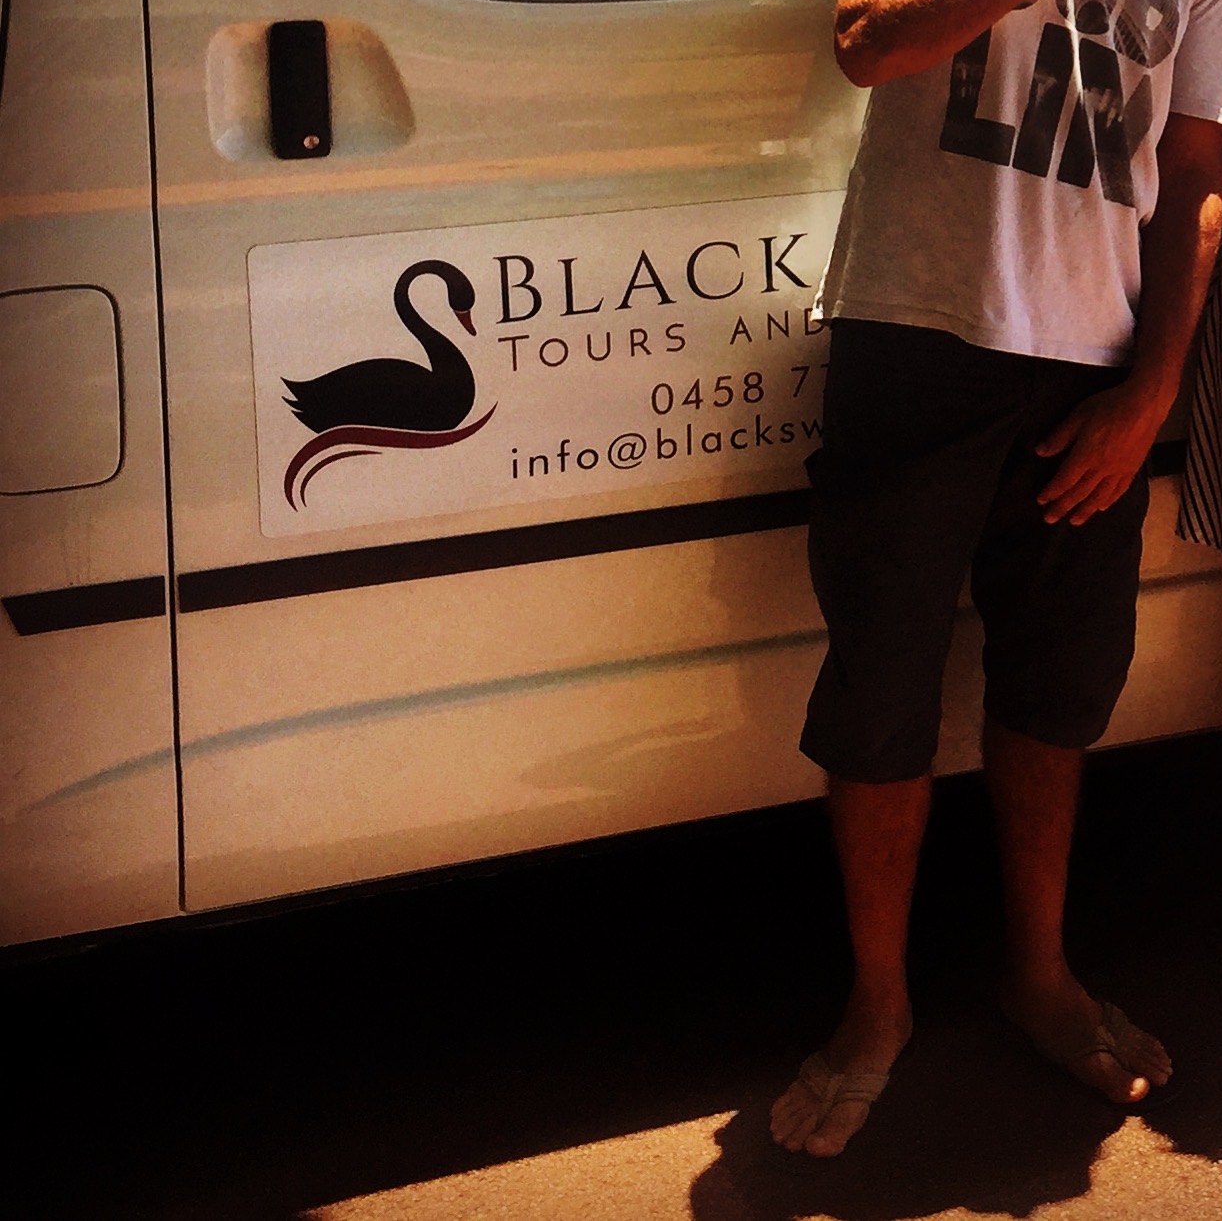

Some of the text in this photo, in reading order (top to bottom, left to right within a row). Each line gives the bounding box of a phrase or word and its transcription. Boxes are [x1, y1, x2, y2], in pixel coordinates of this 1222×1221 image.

[493, 232, 812, 325] BLACK
[497, 307, 826, 372] TOURS AND
[650, 371, 765, 416] 0458
